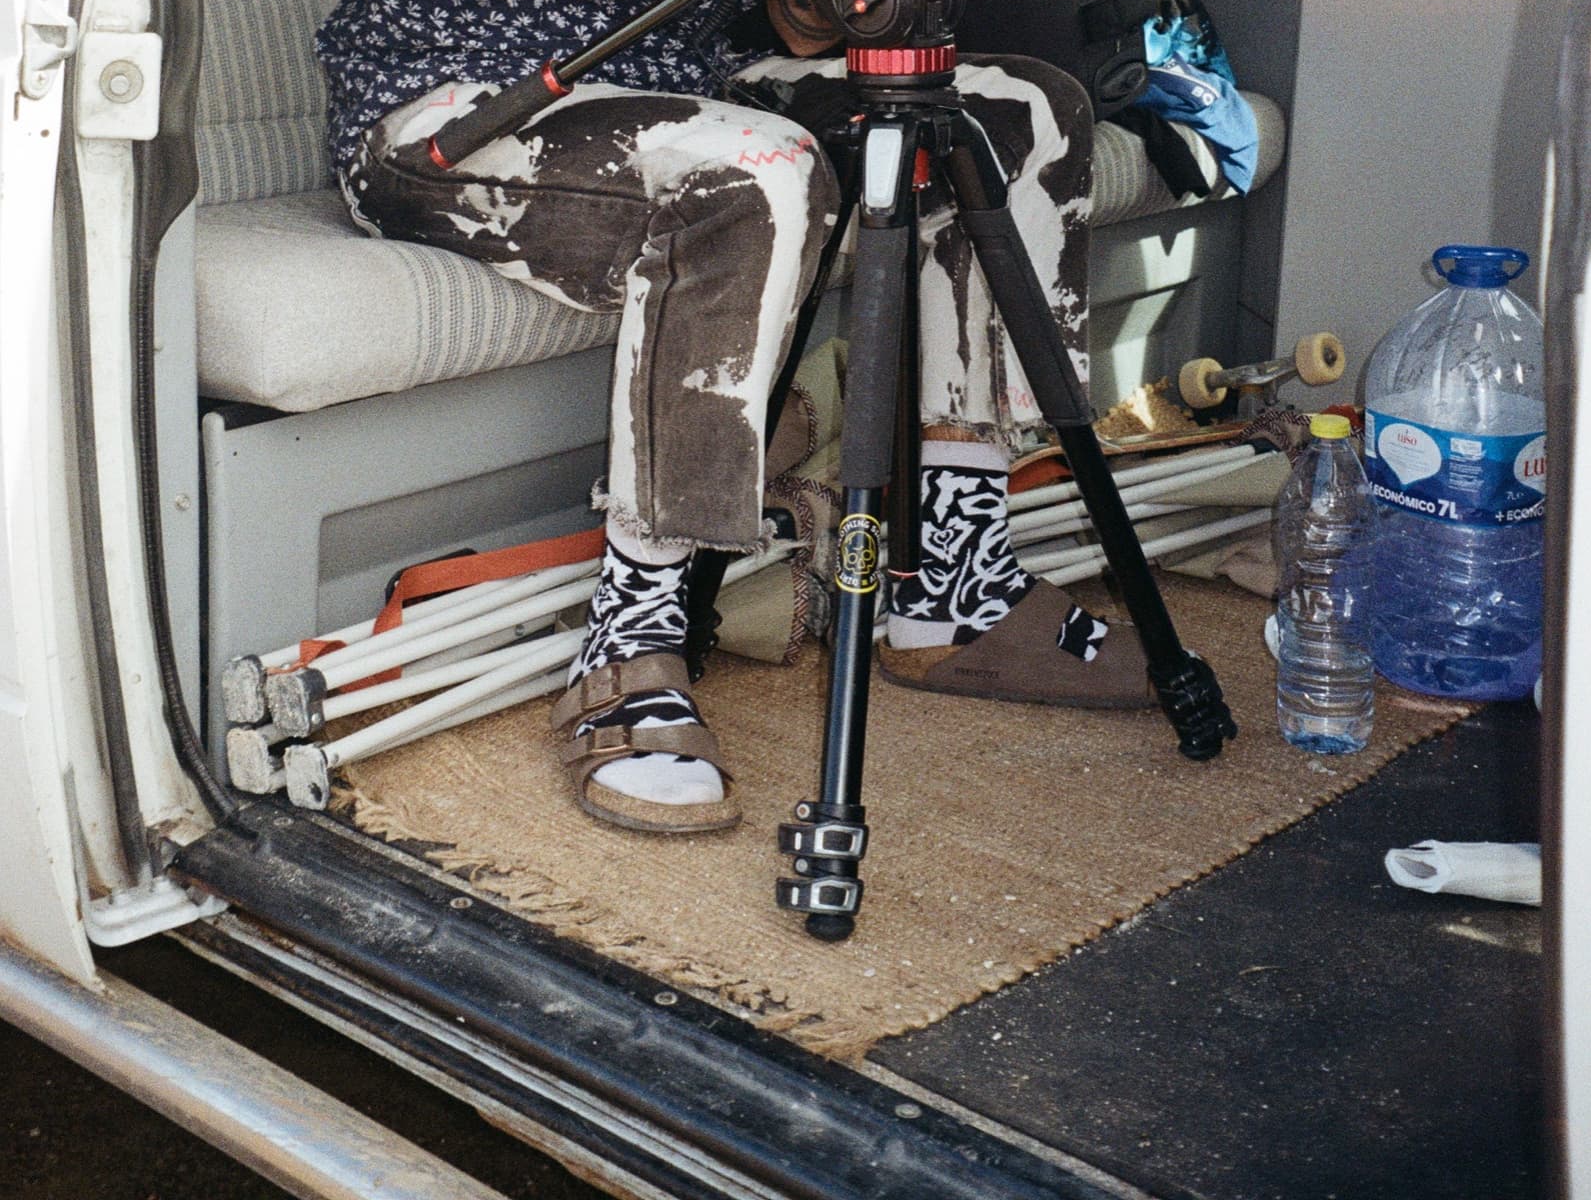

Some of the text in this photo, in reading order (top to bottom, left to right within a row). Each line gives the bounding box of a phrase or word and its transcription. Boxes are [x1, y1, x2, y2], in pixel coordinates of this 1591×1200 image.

[1524, 456, 1547, 477] LU
[1373, 484, 1459, 520] ECONÓMICO 7L
